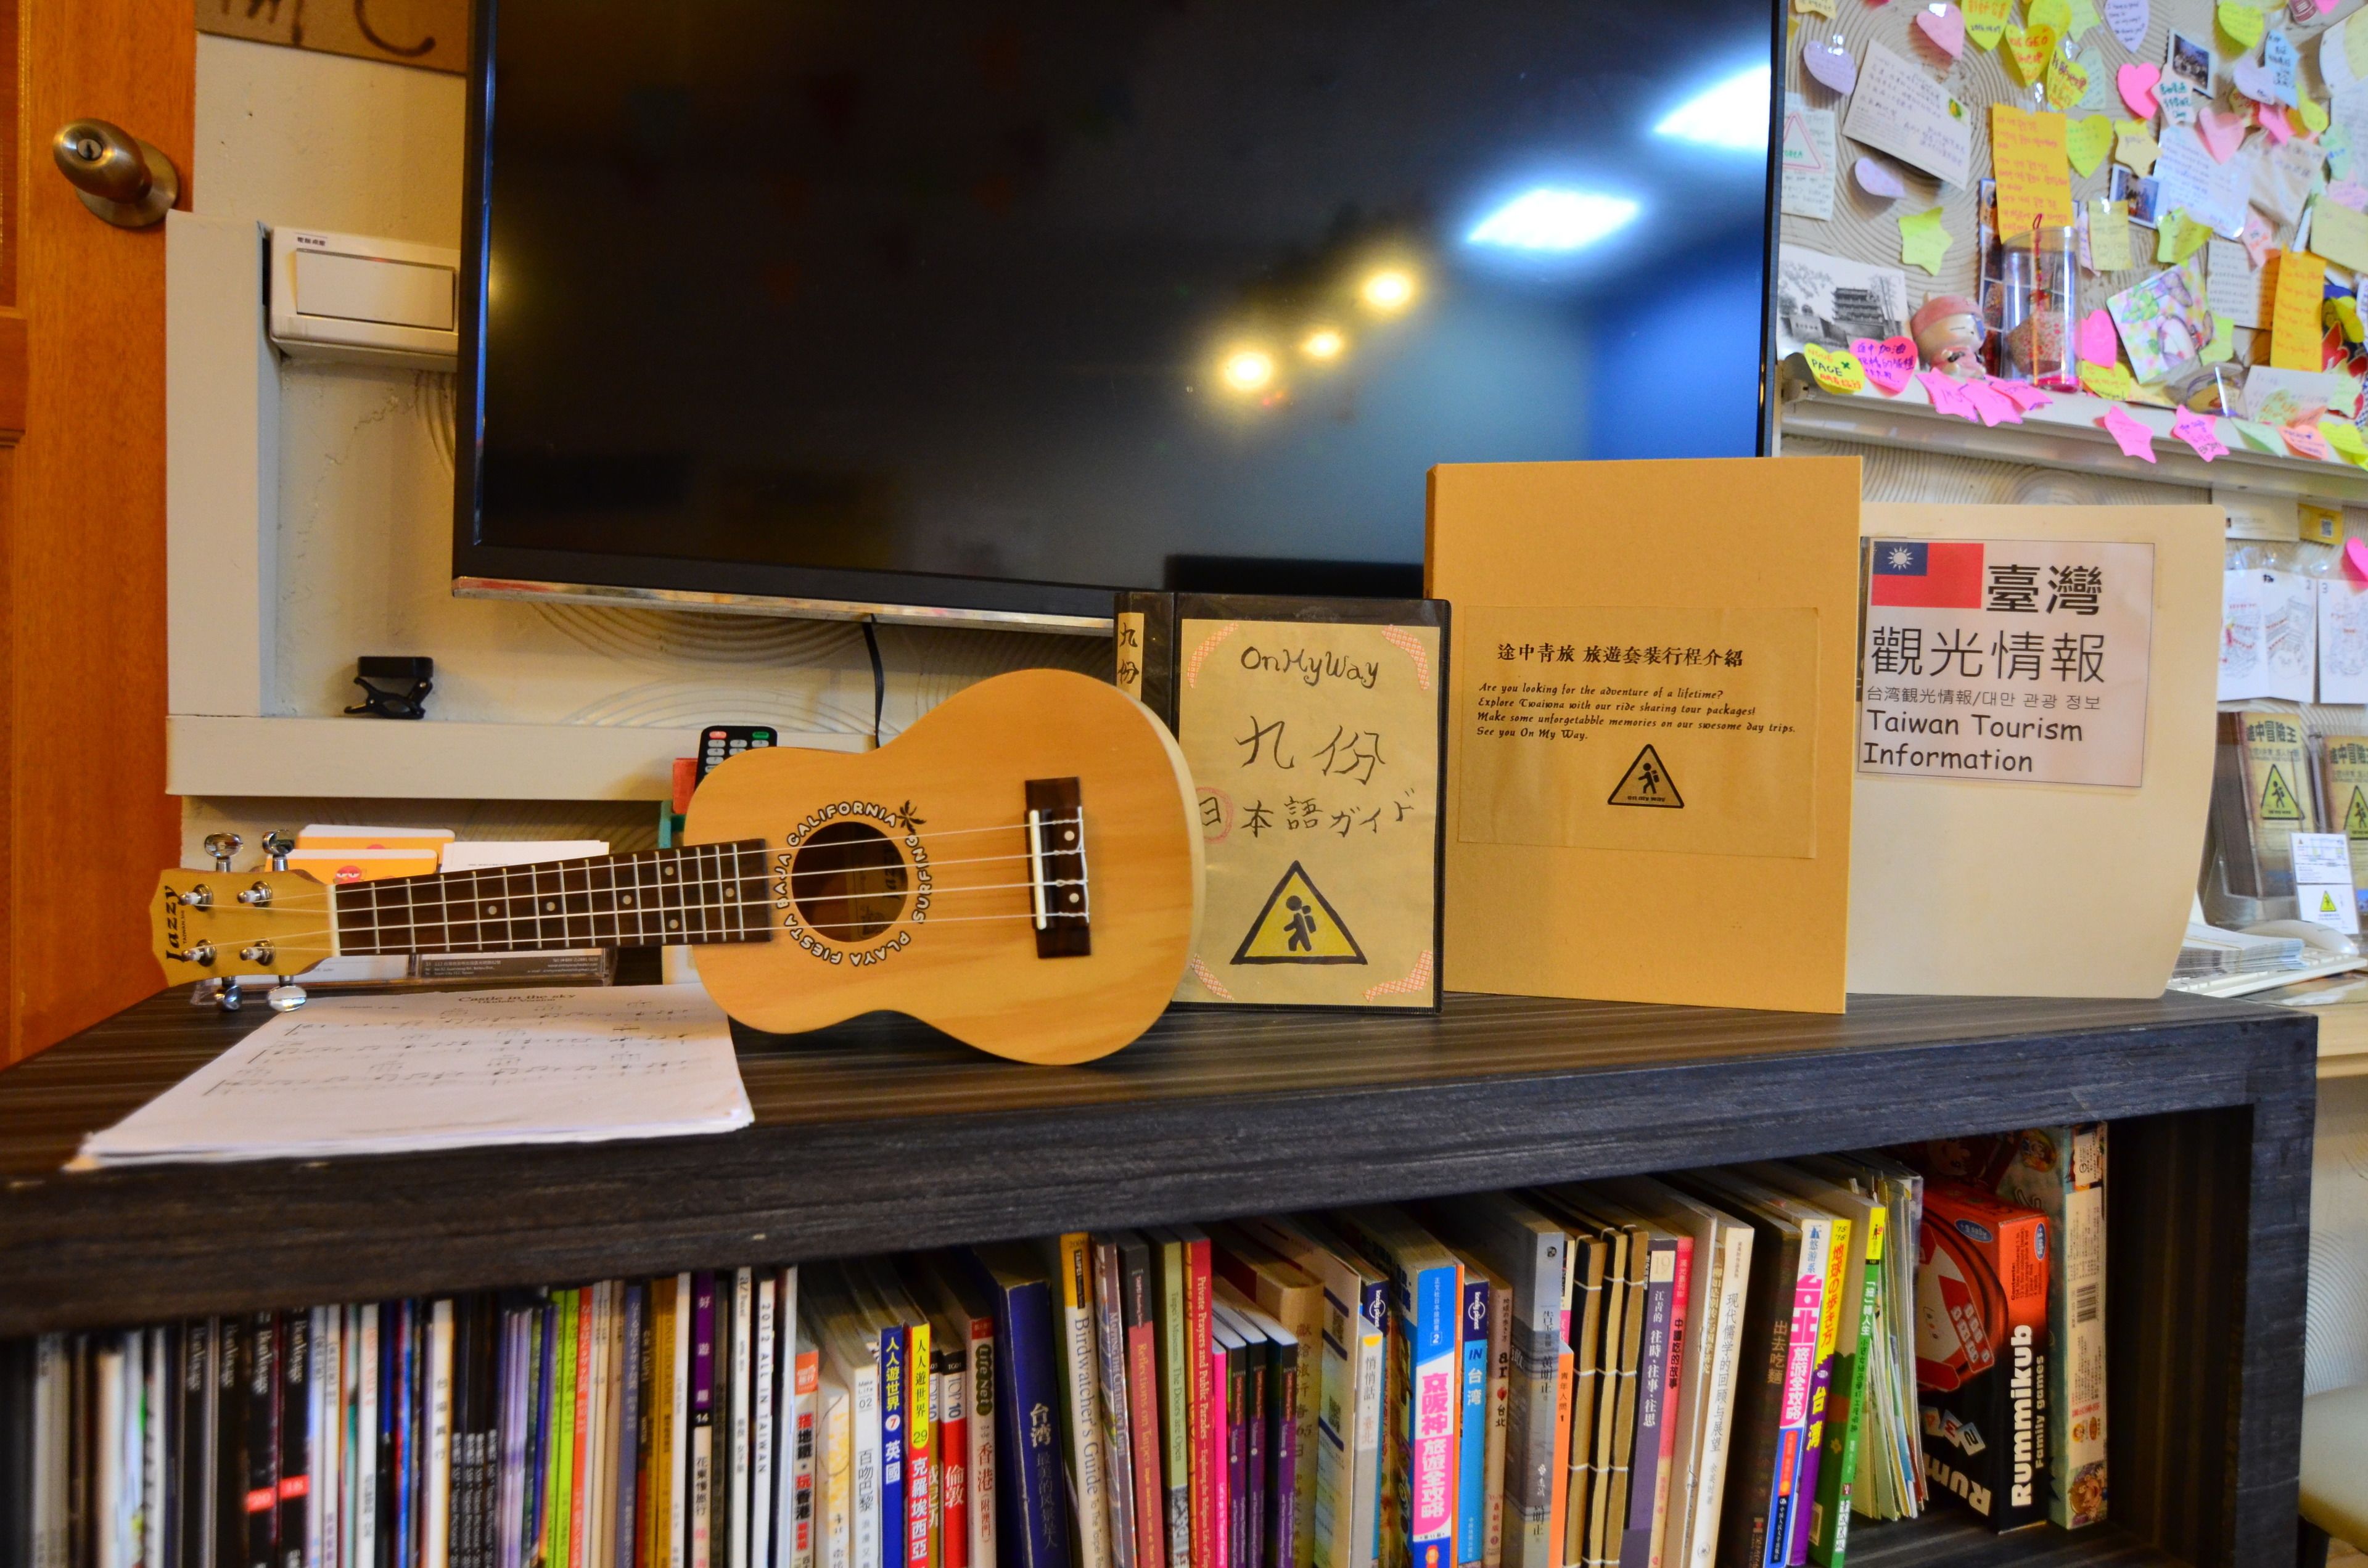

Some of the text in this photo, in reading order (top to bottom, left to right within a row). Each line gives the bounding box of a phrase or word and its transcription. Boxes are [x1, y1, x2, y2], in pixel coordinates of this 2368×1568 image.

[1986, 563, 2103, 616] 臺灣
[1497, 642, 1743, 668] 途中青旅 旅遊套裝行程介紹
[1871, 625, 2105, 683] 觀光情報
[1478, 697, 1515, 710] Explore
[1569, 699, 1591, 710] with
[1616, 702, 1635, 711] ride
[1640, 702, 1677, 715] sharing
[1680, 705, 1702, 714] tour
[1706, 703, 1756, 717] packages!
[1479, 683, 1497, 692] Are
[1501, 684, 1518, 694] you
[1523, 683, 1557, 696] looking
[1561, 683, 1576, 696] for
[1580, 684, 1595, 695] the
[1600, 686, 1649, 697] adventure
[1653, 687, 1664, 698] of
[1677, 688, 1723, 699] lifetime?
[1476, 726, 1589, 741] See you On My Way.
[1477, 710, 1506, 721] Make
[1510, 715, 1534, 723] some
[1609, 717, 1657, 727] memories
[1746, 722, 1764, 733] day
[1769, 723, 1796, 734] trips.
[1866, 708, 2084, 742] Taiwan Tourism
[1863, 742, 2033, 773] Information
[773, 800, 898, 909] BAJA CALIFORNIA
[905, 834, 932, 925] SURFING
[164, 884, 186, 964] Jazzy
[784, 913, 912, 967] PLAYA FIESTA
[1197, 1276, 1207, 1314] Private
[1821, 1242, 1844, 1349] 地球の歩き方
[1197, 1315, 1207, 1352] Prayers
[1432, 1333, 1440, 1344] 2
[1668, 1318, 1684, 1389] 中國吃的故事
[886, 1336, 900, 1411] 人人遊世界
[1198, 1353, 1207, 1369] and
[1468, 1348, 1483, 1360] IN
[1709, 1292, 1739, 1453] 现代儒学的回顾与展望
[757, 1302, 771, 1476] 2012 ALL IN TAIWAN
[915, 1339, 927, 1418] 人人遊世界
[1074, 1317, 1099, 1438] Birdwatcher's
[1137, 1343, 1153, 1408] Reflections
[1172, 1366, 1183, 1385] The
[1199, 1370, 1209, 1402] Public
[1467, 1368, 1483, 1406] 台湾
[1786, 1345, 1809, 1422] 旅游全攻略
[859, 1398, 873, 1409] 02
[948, 1377, 962, 1419] TOP 10
[1172, 1387, 1183, 1417] Doors
[1421, 1371, 1450, 1437] 京阪神
[1495, 1403, 1506, 1428] 台北
[2010, 1323, 2034, 1509] Rummikub
[2034, 1354, 2046, 1470] Family games
[890, 1418, 896, 1429] 7
[913, 1429, 928, 1443] 29
[1174, 1419, 1183, 1435] are
[1199, 1403, 1209, 1440] Parades
[886, 1441, 900, 1485] 英國
[977, 1444, 993, 1493] 香港
[1083, 1443, 1102, 1495] Guide
[1172, 1436, 1184, 1462] Open
[945, 1464, 965, 1510] 倫敦
[1420, 1438, 1448, 1519] 旅遊全攻略
[911, 1456, 928, 1560] 克羅埃西亞
[1091, 1510, 1101, 1529] The
[1092, 1529, 1103, 1554] Taipei
